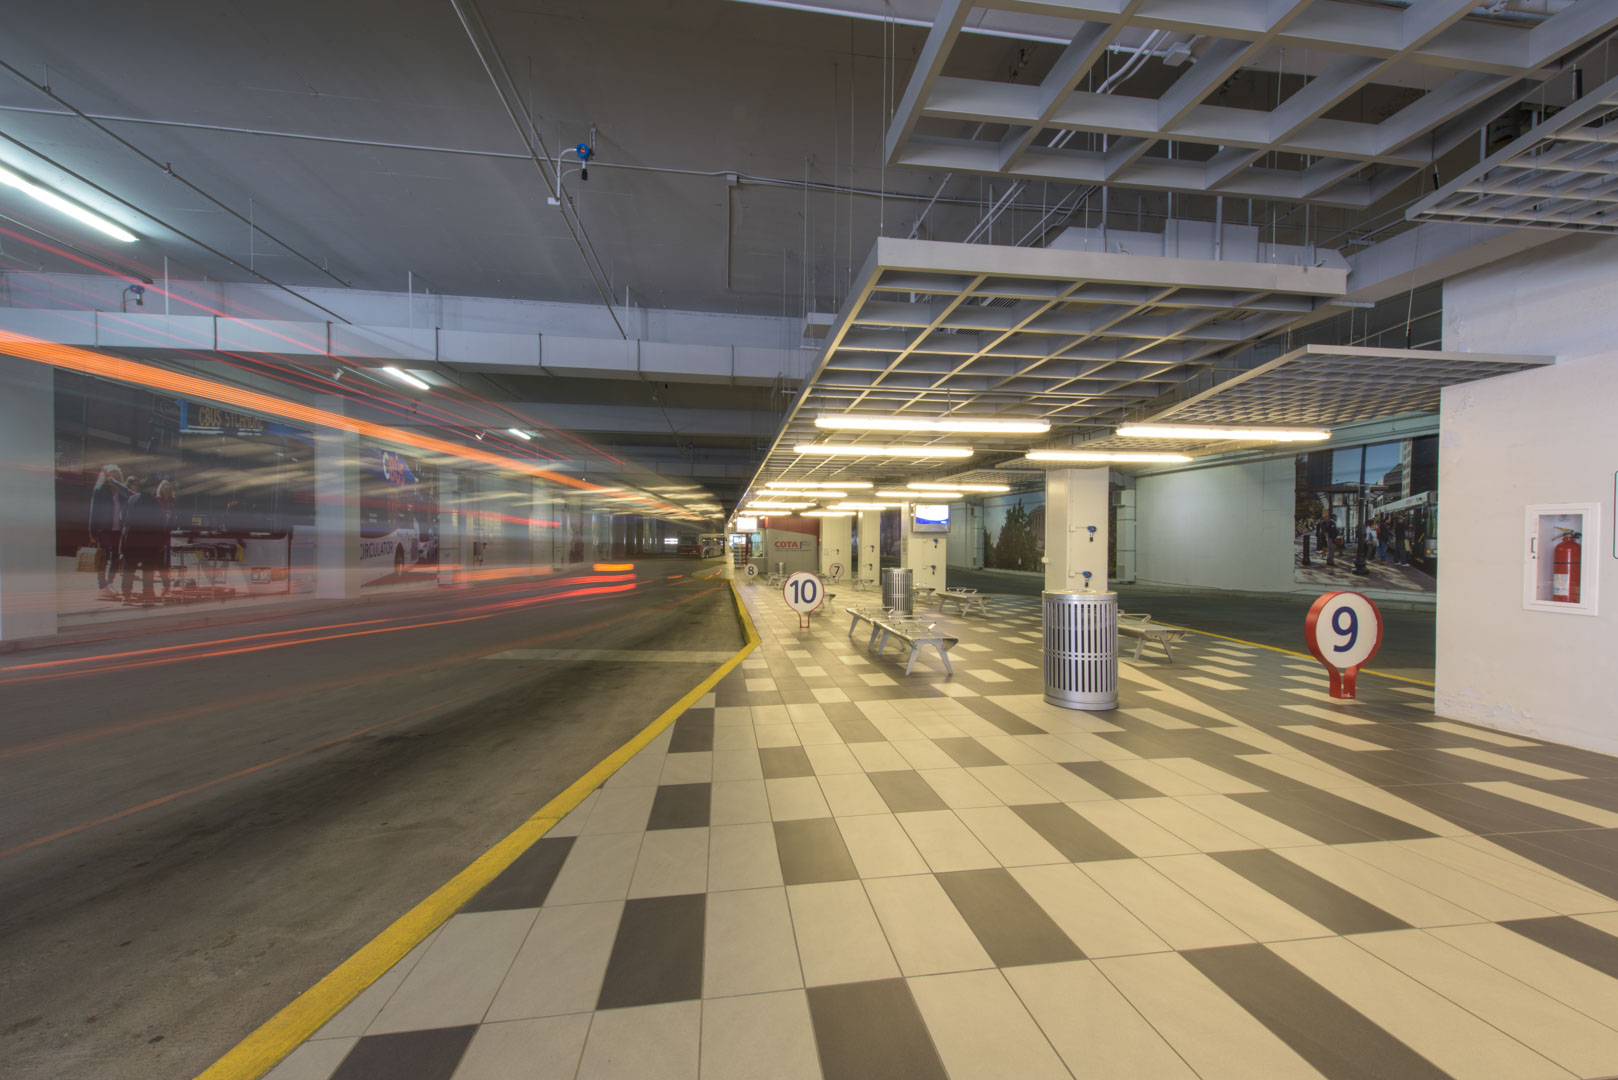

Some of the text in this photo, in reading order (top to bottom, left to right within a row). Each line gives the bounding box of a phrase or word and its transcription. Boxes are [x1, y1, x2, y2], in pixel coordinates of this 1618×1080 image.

[748, 566, 755, 576] 8
[834, 566, 841, 575] 7
[789, 579, 817, 604] 10
[1331, 606, 1359, 653] 9
